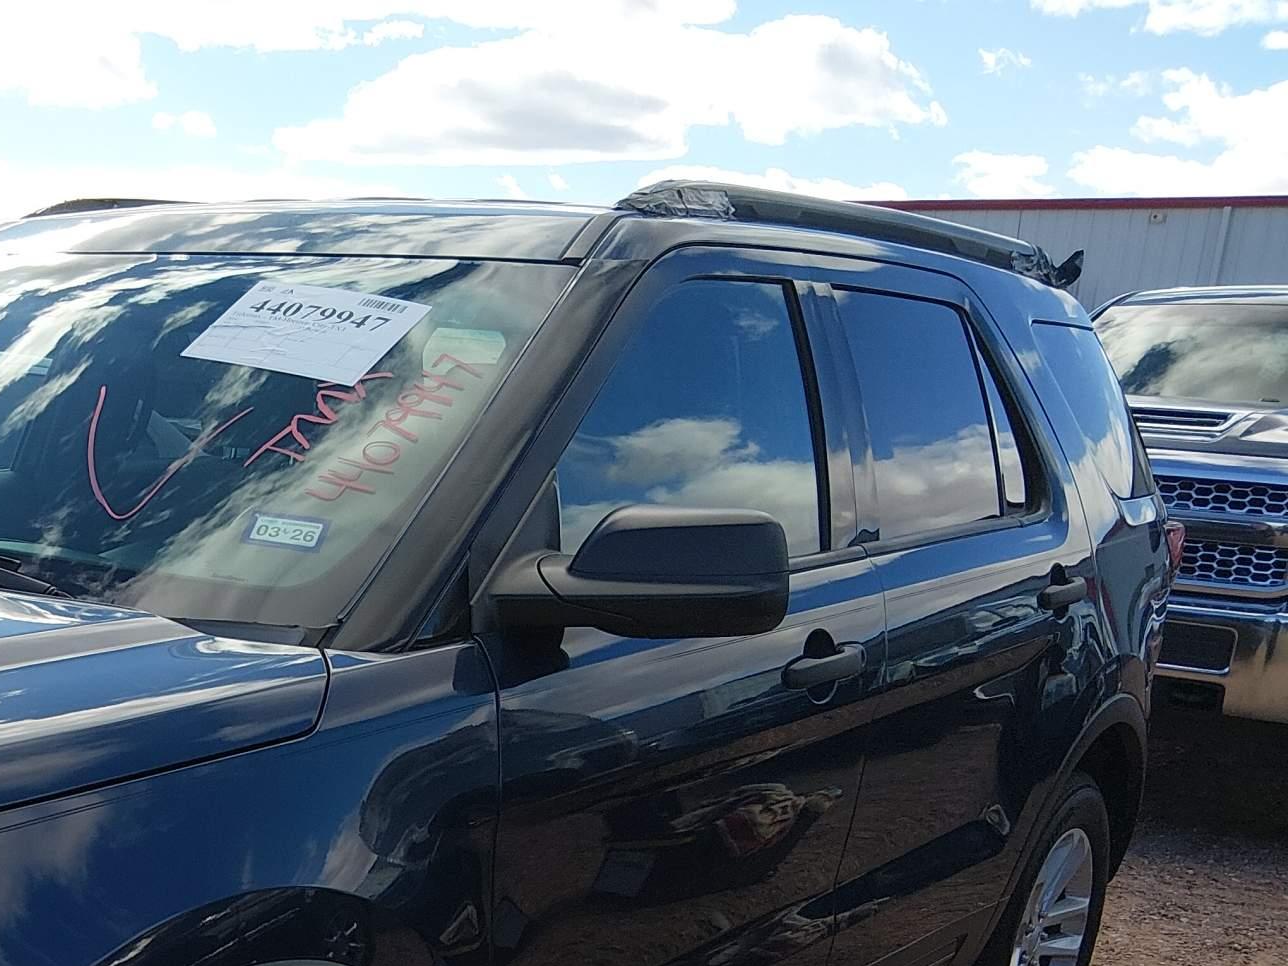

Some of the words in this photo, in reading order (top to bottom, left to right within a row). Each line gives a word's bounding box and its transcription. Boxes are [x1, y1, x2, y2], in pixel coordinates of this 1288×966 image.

[249, 298, 393, 332] 44079947
[304, 353, 483, 501] 44079947
[255, 524, 281, 538] 03
[289, 528, 317, 543] 26
